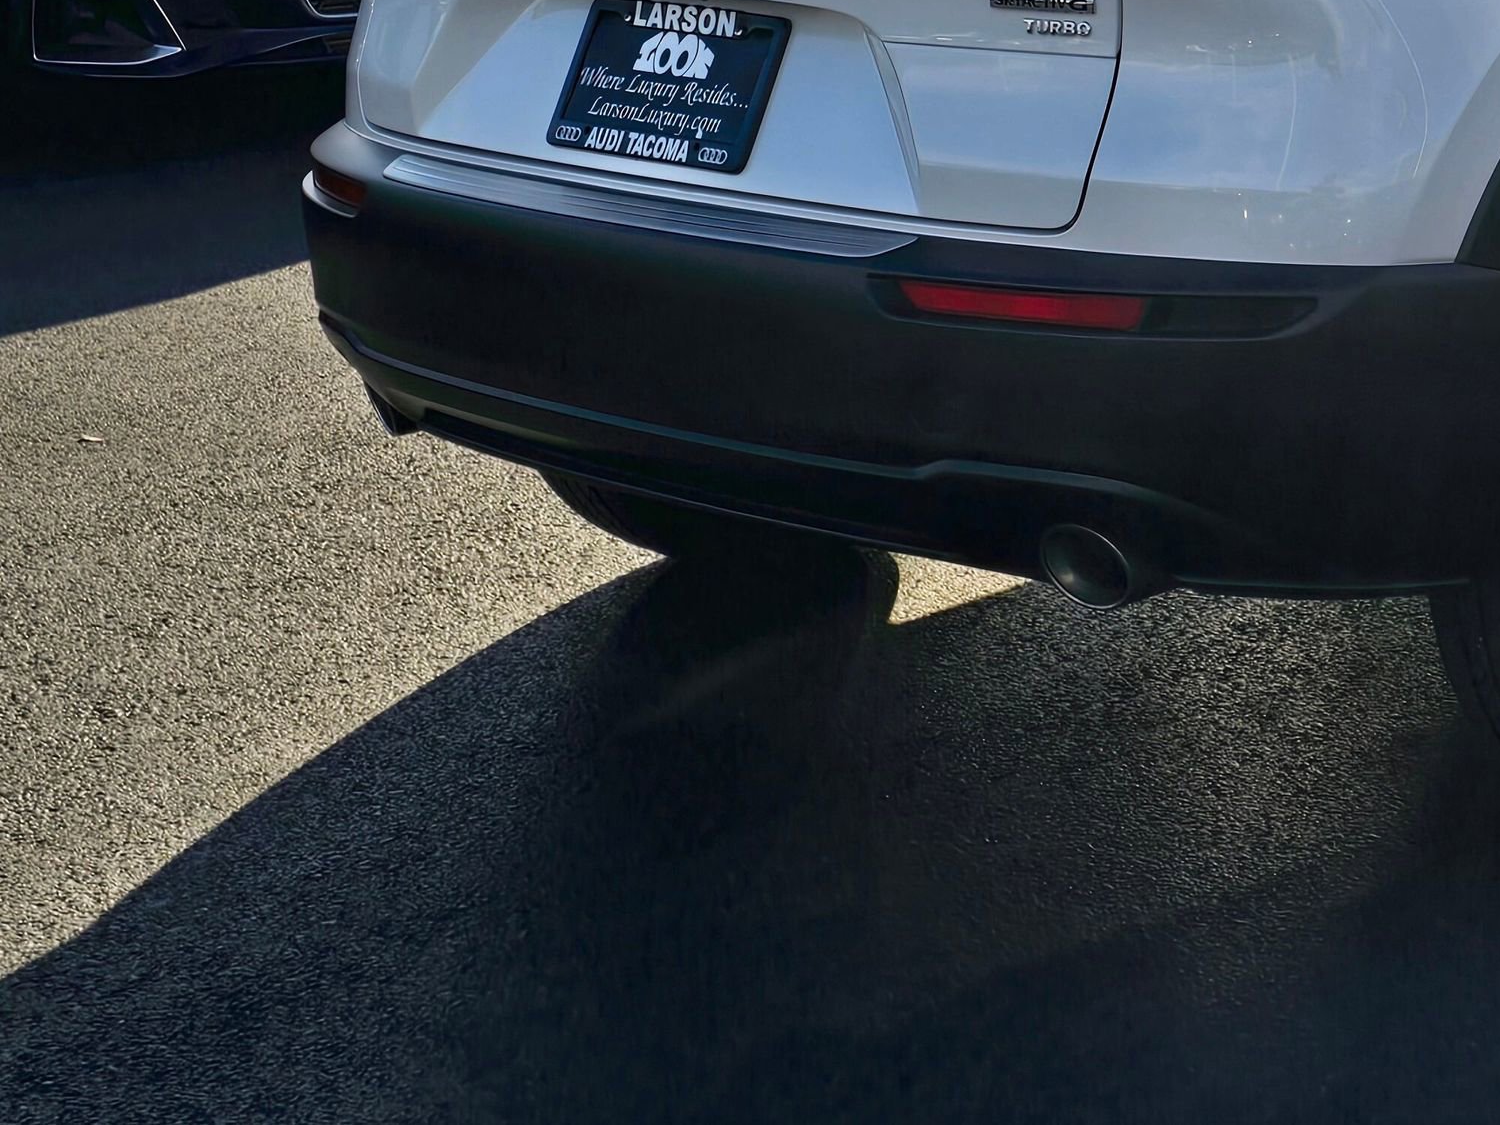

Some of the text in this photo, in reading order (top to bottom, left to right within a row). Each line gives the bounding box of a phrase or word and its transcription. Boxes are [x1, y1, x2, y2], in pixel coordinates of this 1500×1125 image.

[633, 0, 737, 37] LARSON
[1023, 18, 1092, 36] TURBO
[579, 65, 748, 108] Where Luxury Resides...
[588, 96, 722, 135] LarsonLuxury.com
[584, 126, 690, 162] AUDI TACOMA
